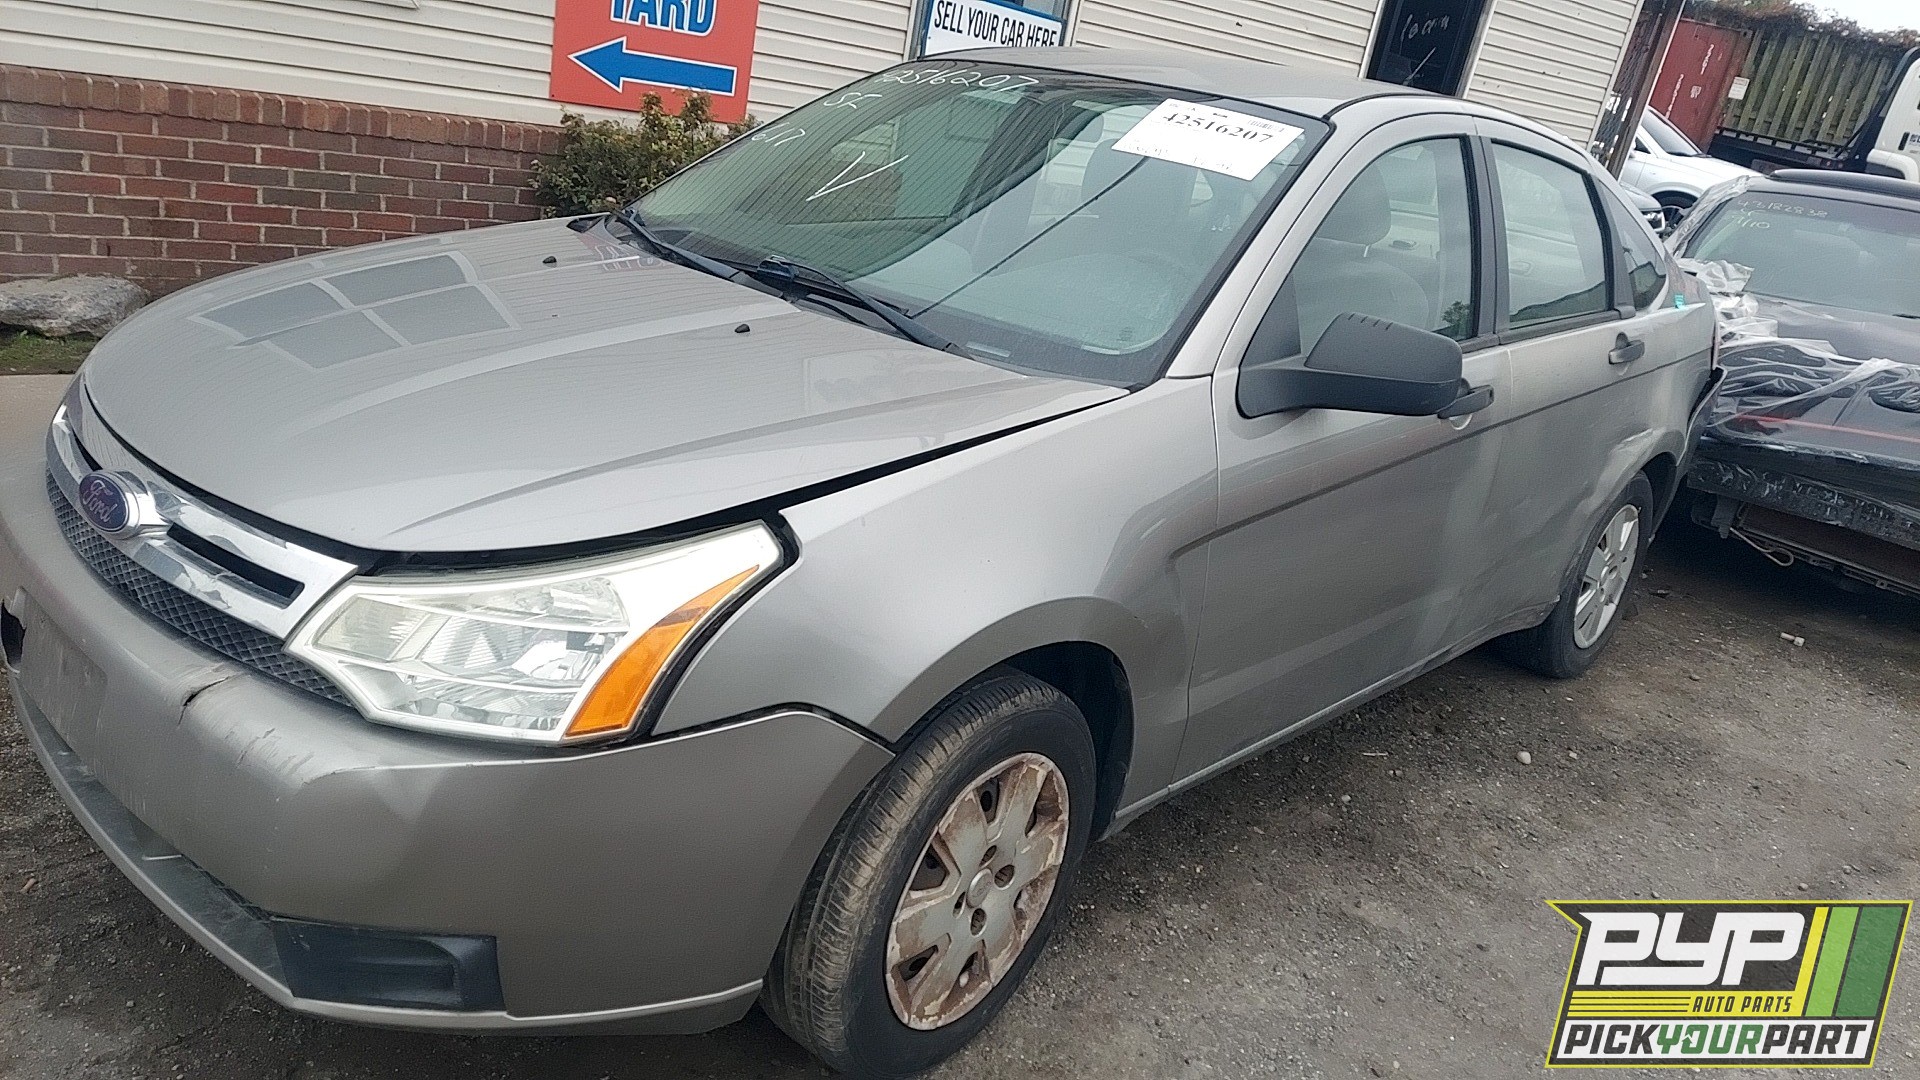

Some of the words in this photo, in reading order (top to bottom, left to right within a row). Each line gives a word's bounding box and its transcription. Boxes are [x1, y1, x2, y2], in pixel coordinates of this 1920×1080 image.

[934, 0, 964, 34] SELL
[967, 7, 1000, 43] YOUR
[1000, 17, 1025, 47] CAR
[1163, 112, 1273, 143] 42516207
[82, 479, 119, 523] Ford
